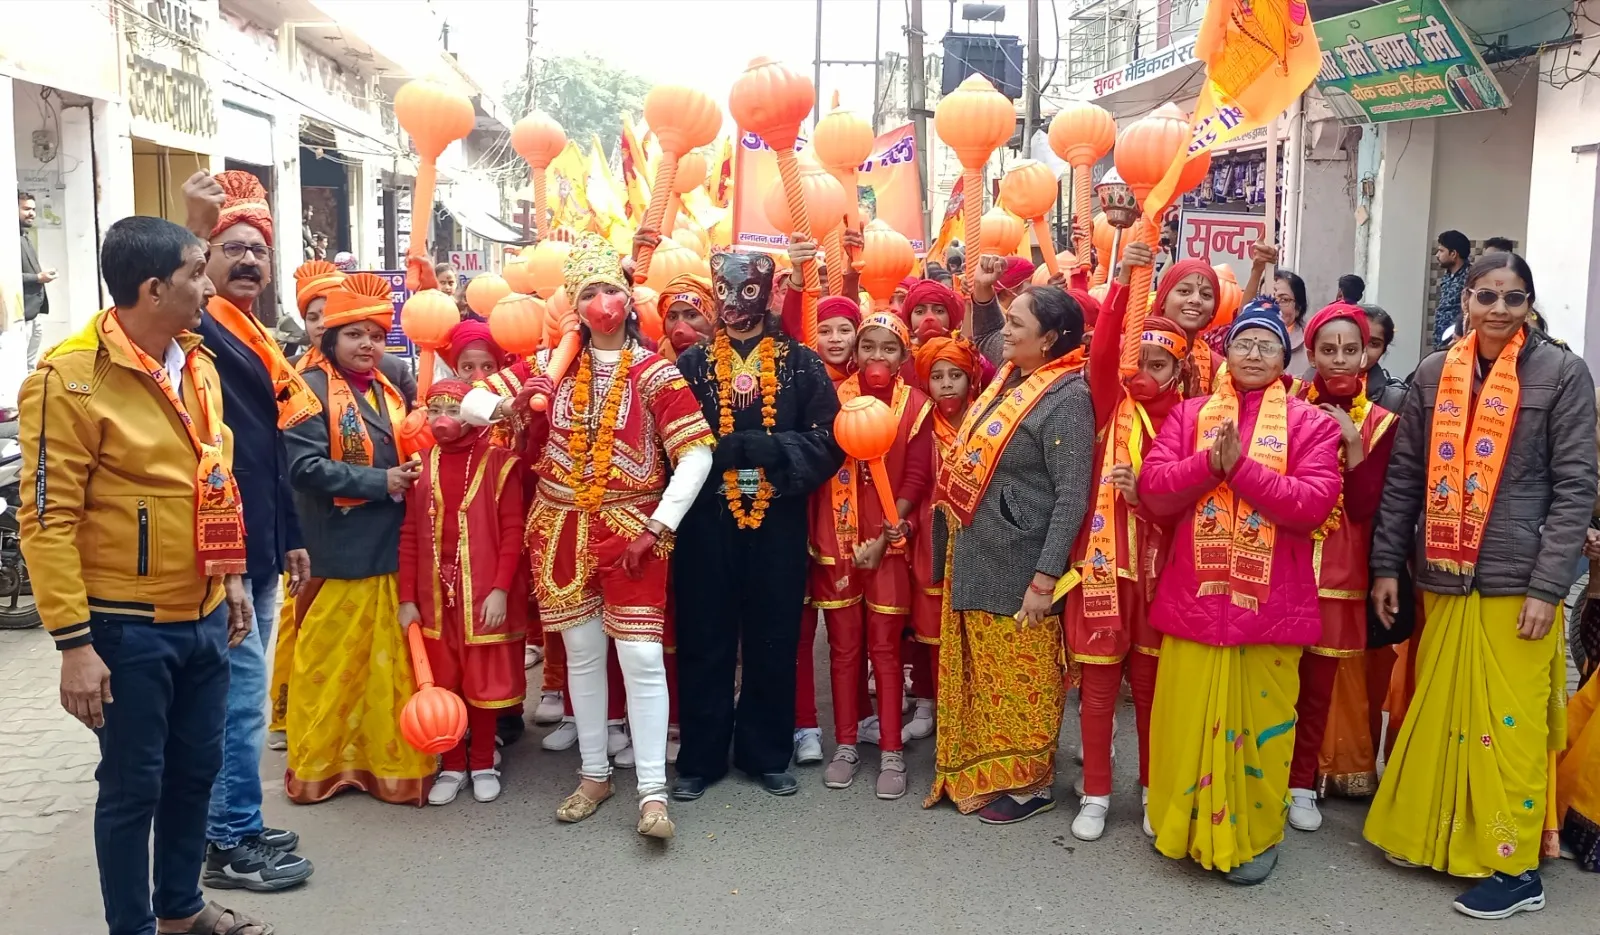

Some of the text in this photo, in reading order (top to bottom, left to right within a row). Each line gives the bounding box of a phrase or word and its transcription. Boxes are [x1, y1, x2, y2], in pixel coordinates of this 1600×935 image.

[1335, 34, 1377, 76] अली
[1411, 16, 1461, 62] अली
[1094, 70, 1123, 96] सुन्दर
[1125, 49, 1176, 81] मेडिकल
[1352, 84, 1377, 101] थोक
[740, 233, 767, 243] सनातन
[770, 235, 782, 244] धर्म
[1186, 219, 1266, 264] सुन्दर
[452, 254, 482, 270] S.M.
[1158, 336, 1174, 349] राम
[1451, 466, 1460, 474] राम
[1484, 464, 1493, 473] राम
